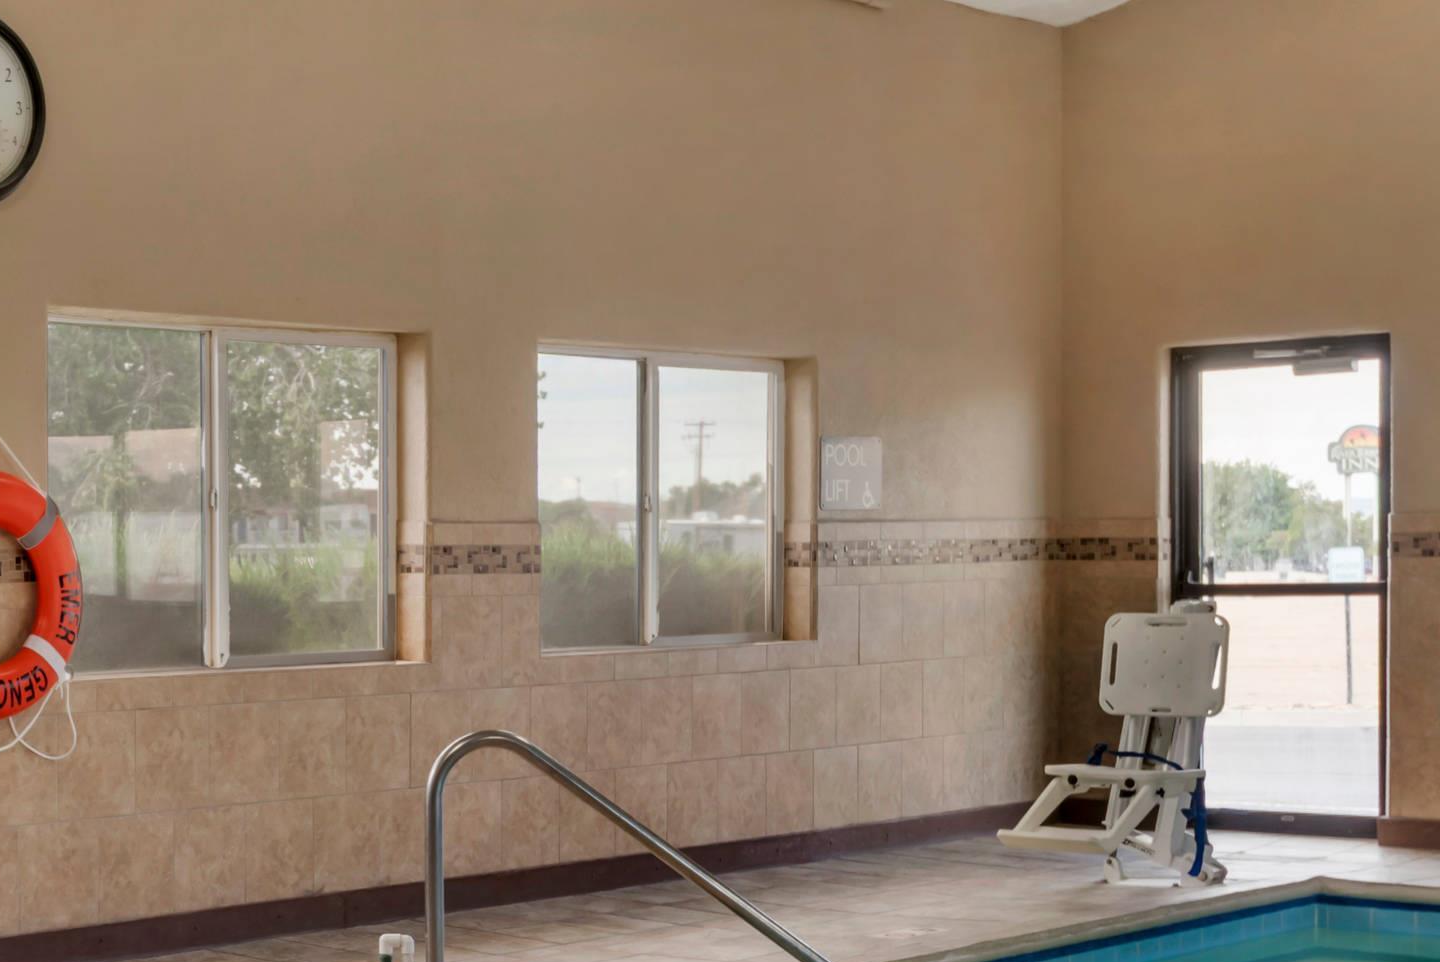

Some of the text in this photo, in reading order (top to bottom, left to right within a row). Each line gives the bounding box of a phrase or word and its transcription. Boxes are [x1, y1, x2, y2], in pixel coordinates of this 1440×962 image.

[4, 68, 12, 83] 2
[15, 101, 23, 116] 3
[825, 444, 867, 467] POOL
[825, 480, 851, 503] LIFT
